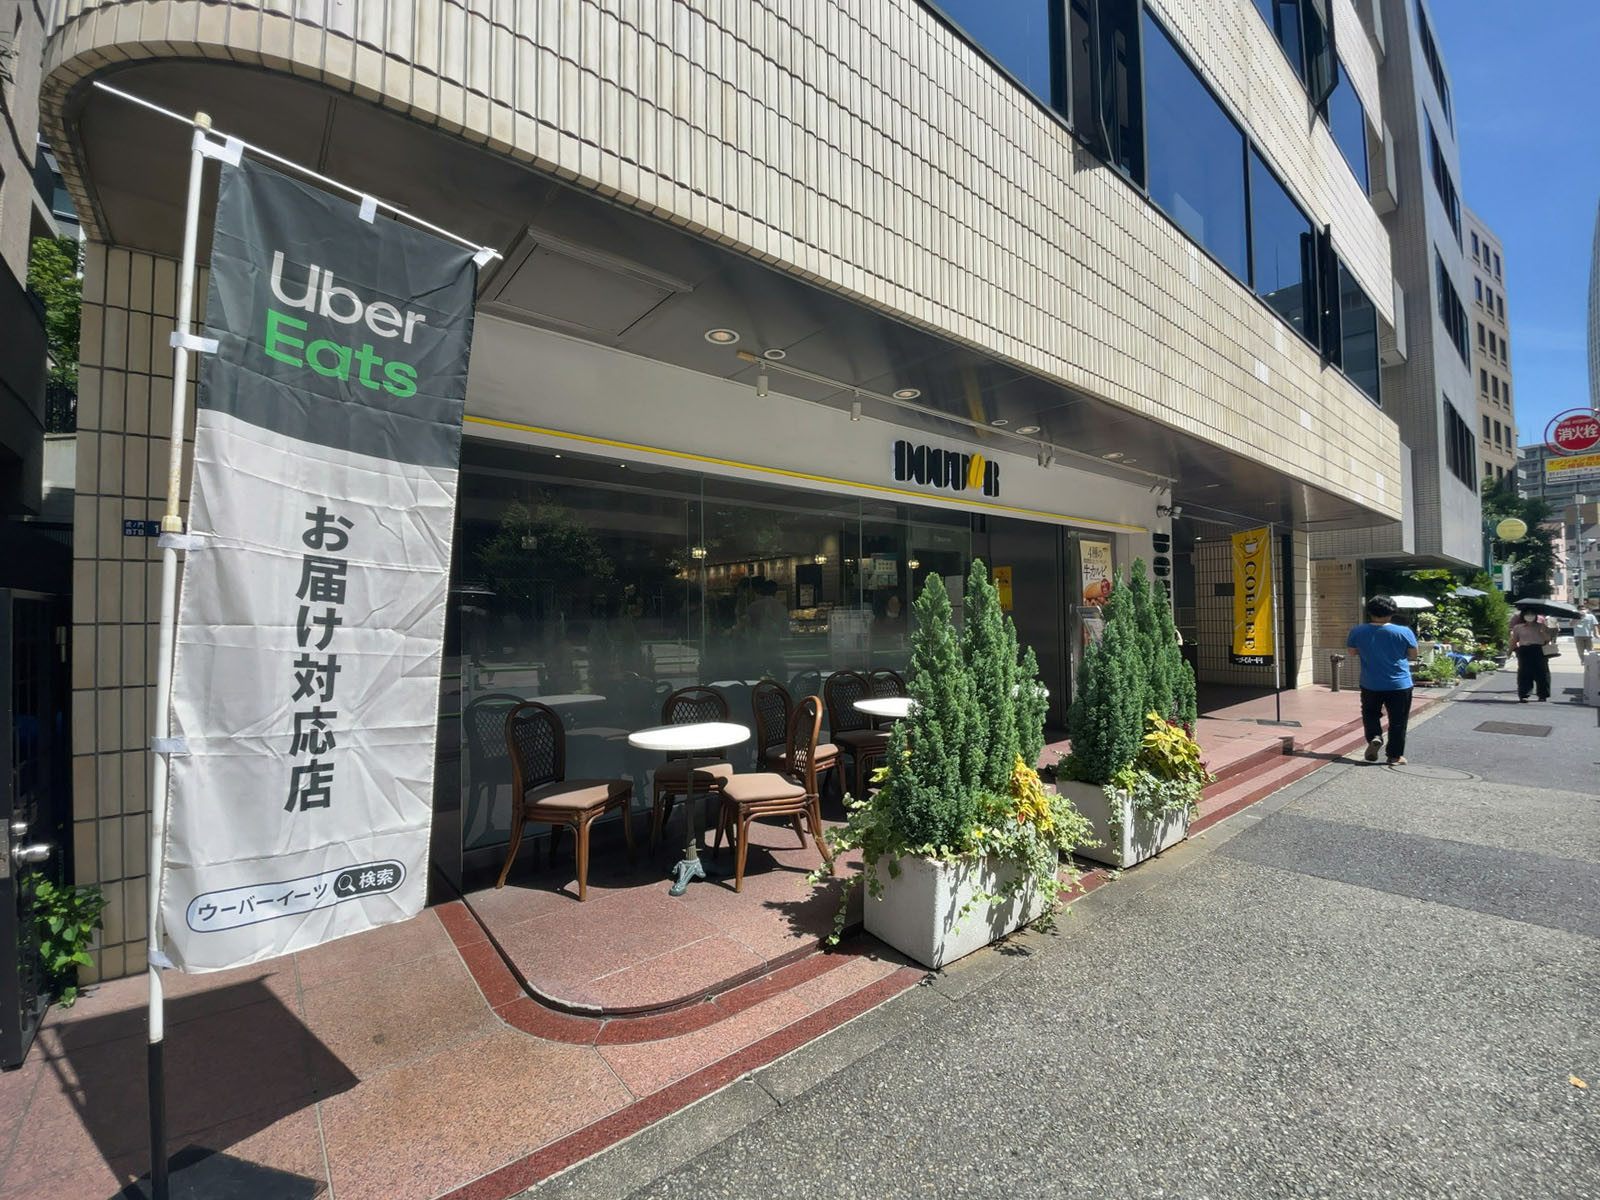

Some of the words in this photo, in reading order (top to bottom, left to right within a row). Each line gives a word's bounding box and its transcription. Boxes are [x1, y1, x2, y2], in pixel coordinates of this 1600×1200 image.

[270, 250, 426, 344] Uber
[265, 308, 417, 398] Eats
[894, 440, 1000, 497] DOUTOR
[1557, 423, 1599, 442] 消火栓
[284, 506, 355, 813] お届け対応店
[198, 883, 328, 921] ウーバーイーツ
[358, 868, 395, 888] 検索
